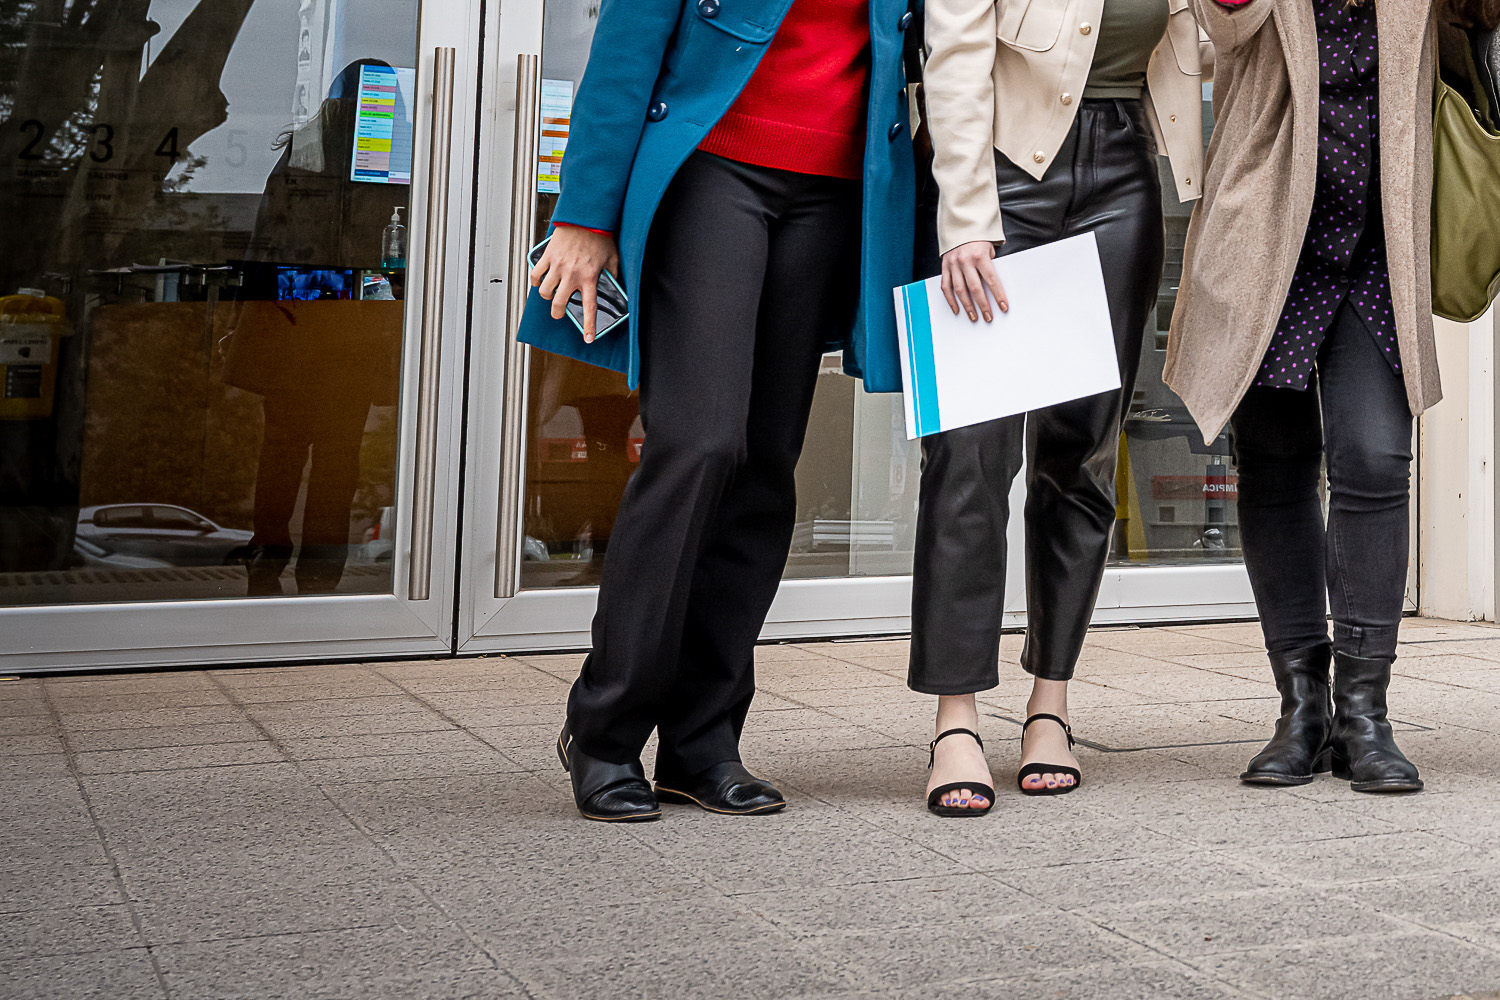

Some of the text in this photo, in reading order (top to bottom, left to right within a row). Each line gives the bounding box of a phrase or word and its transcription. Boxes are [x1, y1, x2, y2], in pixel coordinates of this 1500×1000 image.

[18, 119, 45, 160] 2
[89, 123, 114, 163] 3
[154, 126, 181, 165] 4
[224, 129, 249, 168] 5
[87, 172, 129, 181] SALONES
